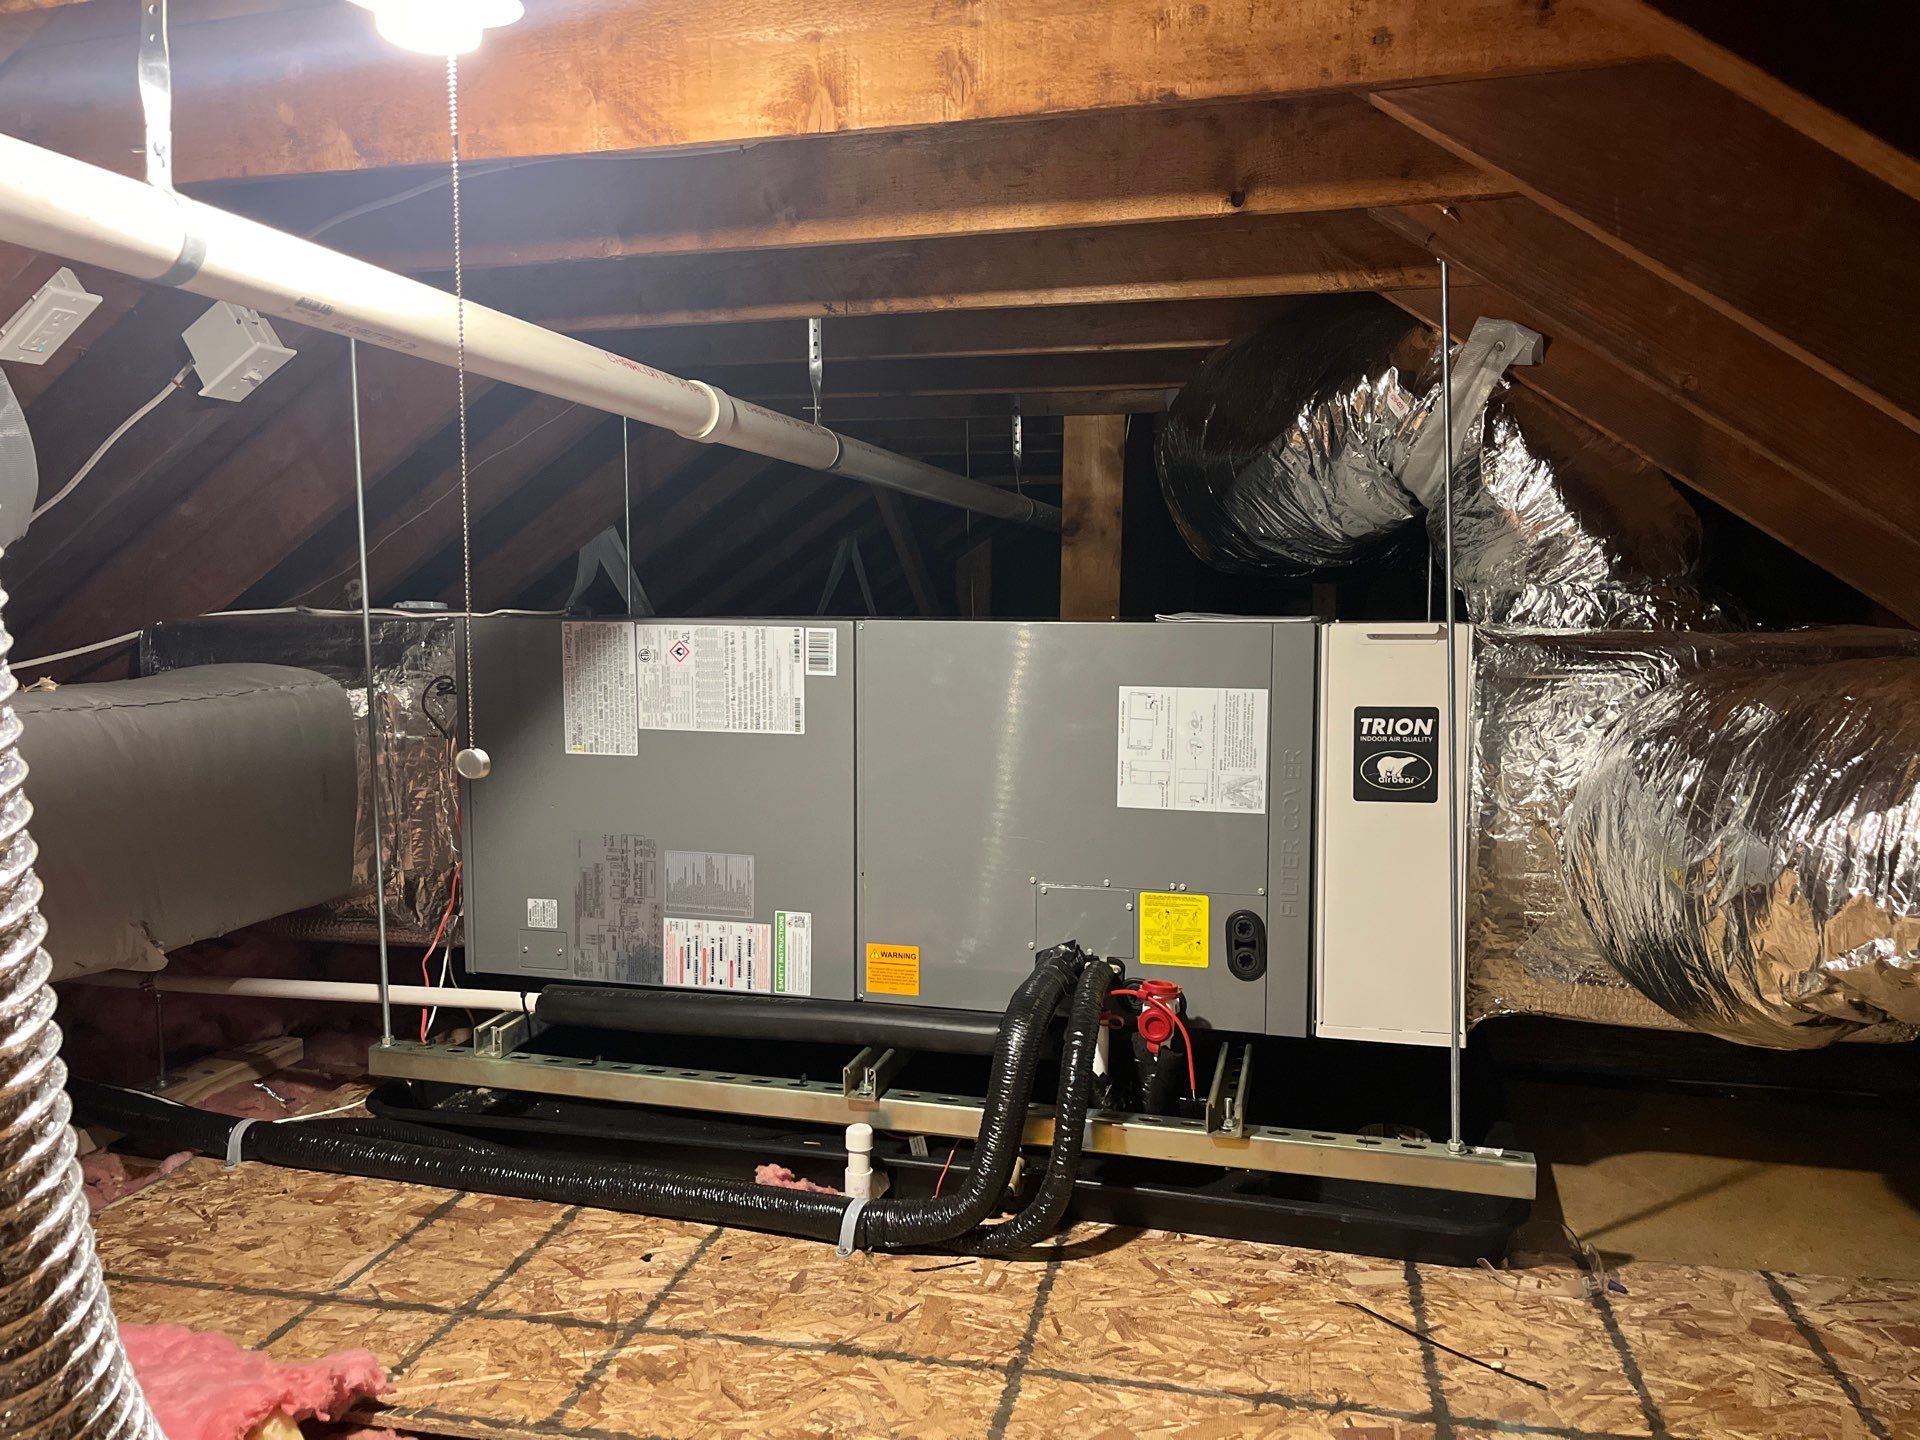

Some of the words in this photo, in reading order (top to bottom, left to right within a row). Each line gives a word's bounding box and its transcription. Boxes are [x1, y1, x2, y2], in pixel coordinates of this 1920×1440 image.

[604, 351, 675, 385] CHARLOTTE
[1360, 718, 1433, 736] TRION
[1282, 748, 1303, 832] COVER
[1378, 774, 1415, 784] airbear
[1280, 838, 1300, 918] FILTER
[880, 951, 917, 960] WARNING
